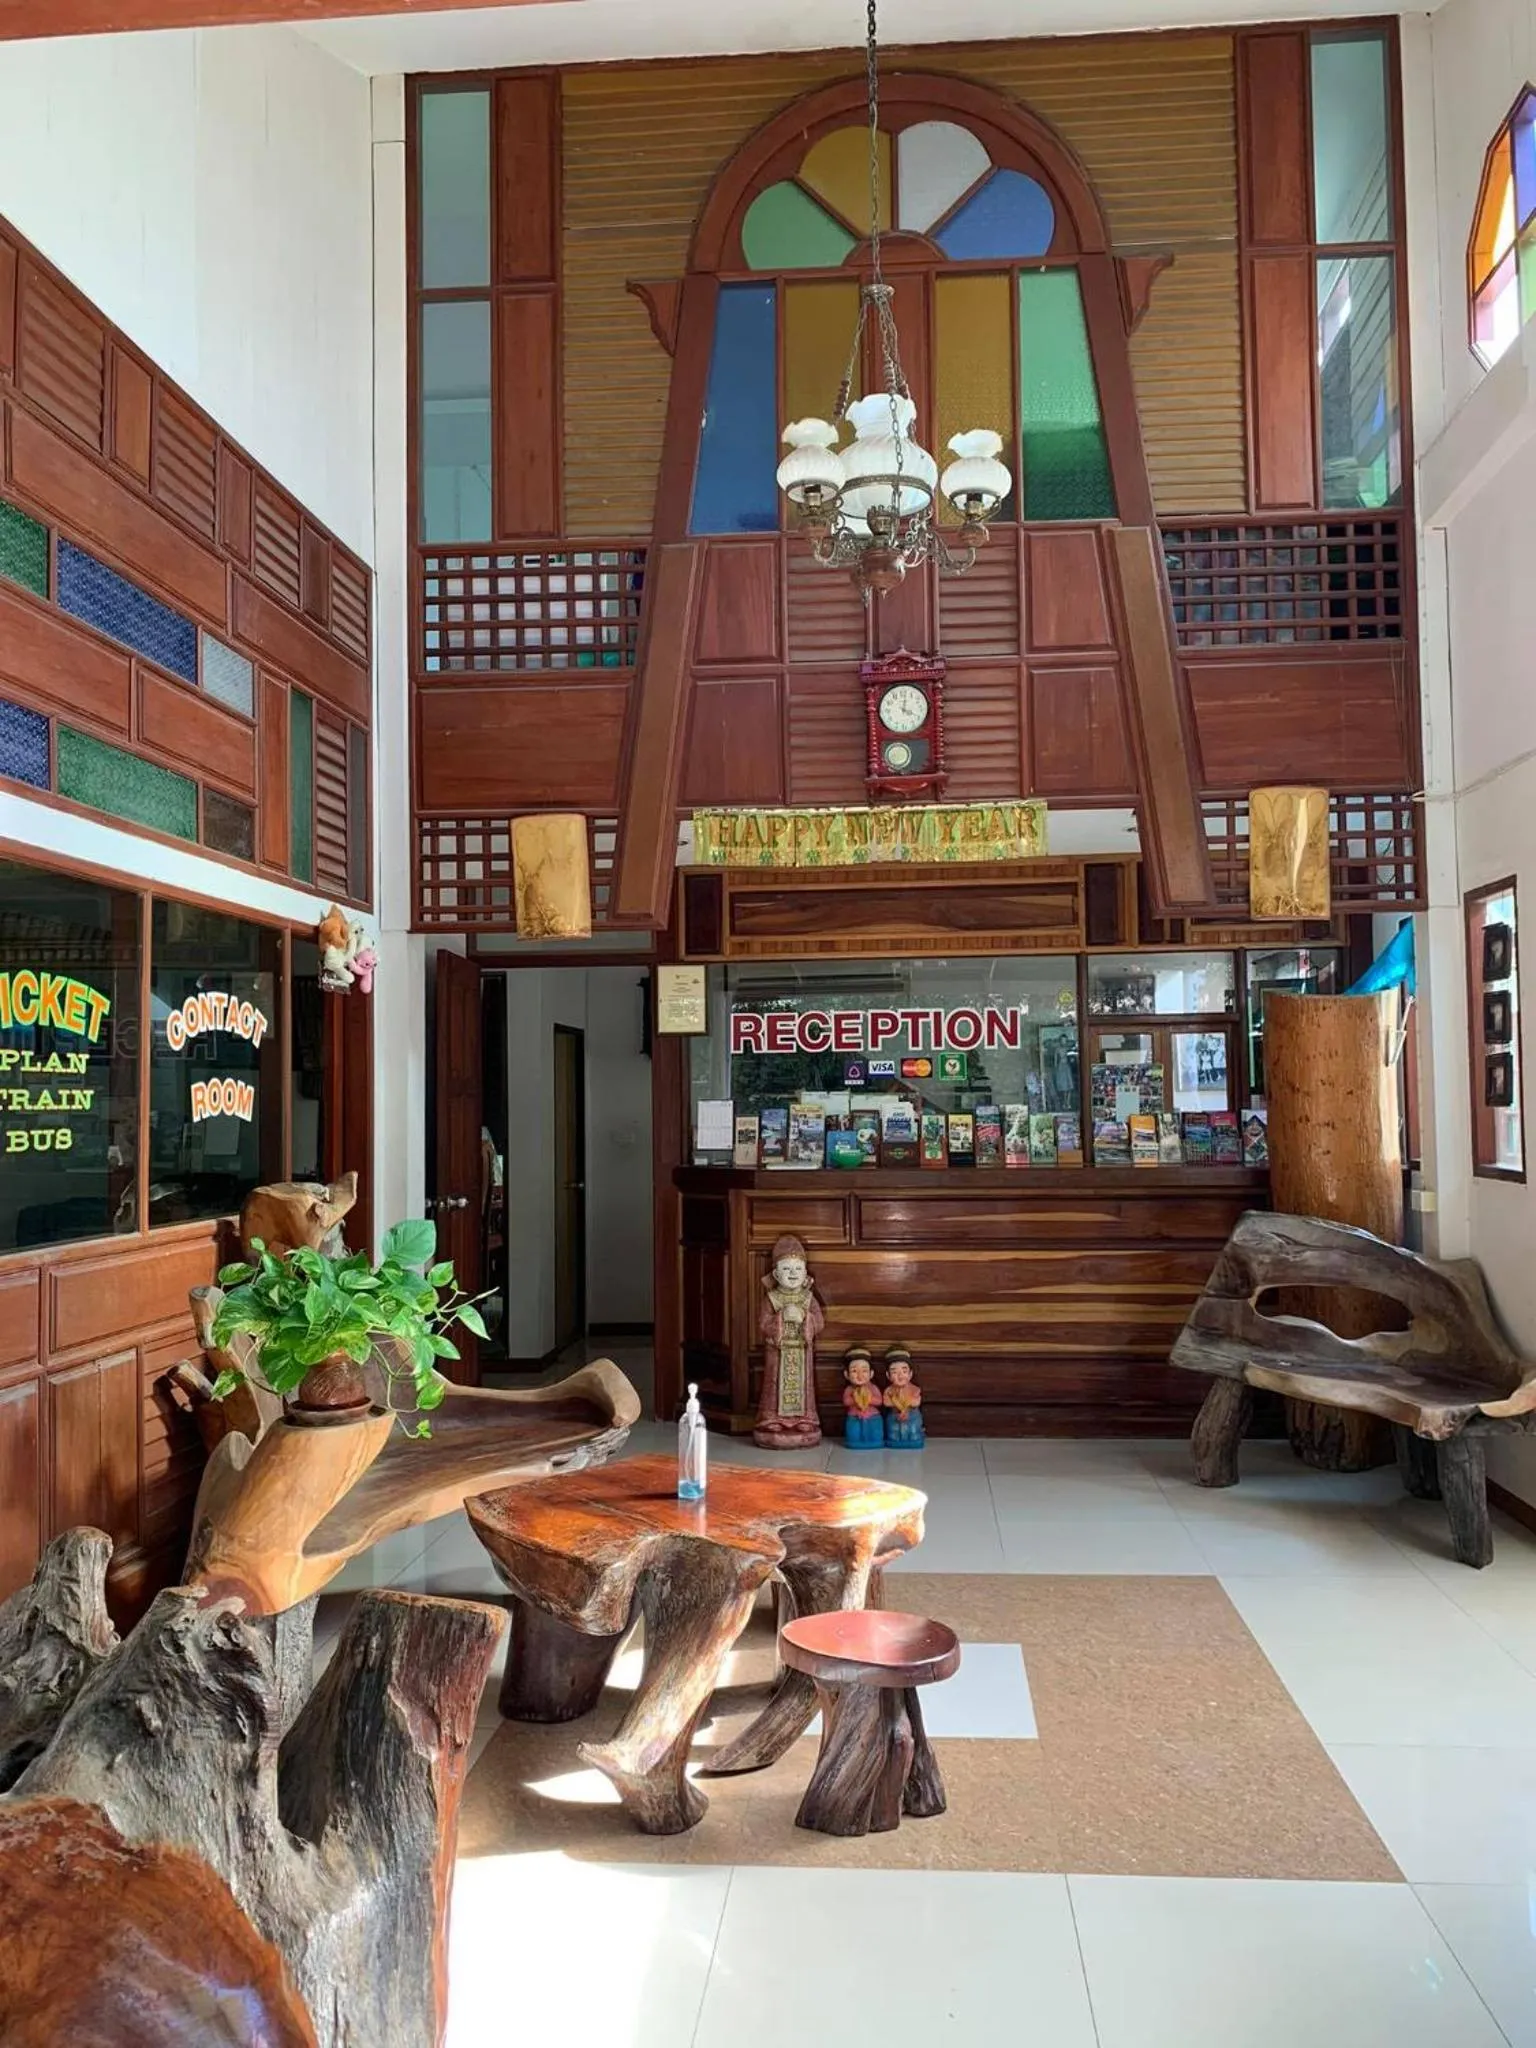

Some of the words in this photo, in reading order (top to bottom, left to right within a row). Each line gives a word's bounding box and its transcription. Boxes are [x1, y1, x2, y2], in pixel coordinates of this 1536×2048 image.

[709, 811, 836, 849] HAPPY
[847, 809, 926, 847] NEW
[932, 806, 1040, 844] YEAR
[0, 969, 111, 1044] ICKET
[166, 990, 269, 1051] CONTACT
[730, 1006, 1021, 1054] RECEPTION
[0, 1049, 90, 1075] PLAN
[871, 1063, 894, 1072] VISA
[190, 1077, 255, 1124] ROOM
[6, 1127, 73, 1153] BUS
